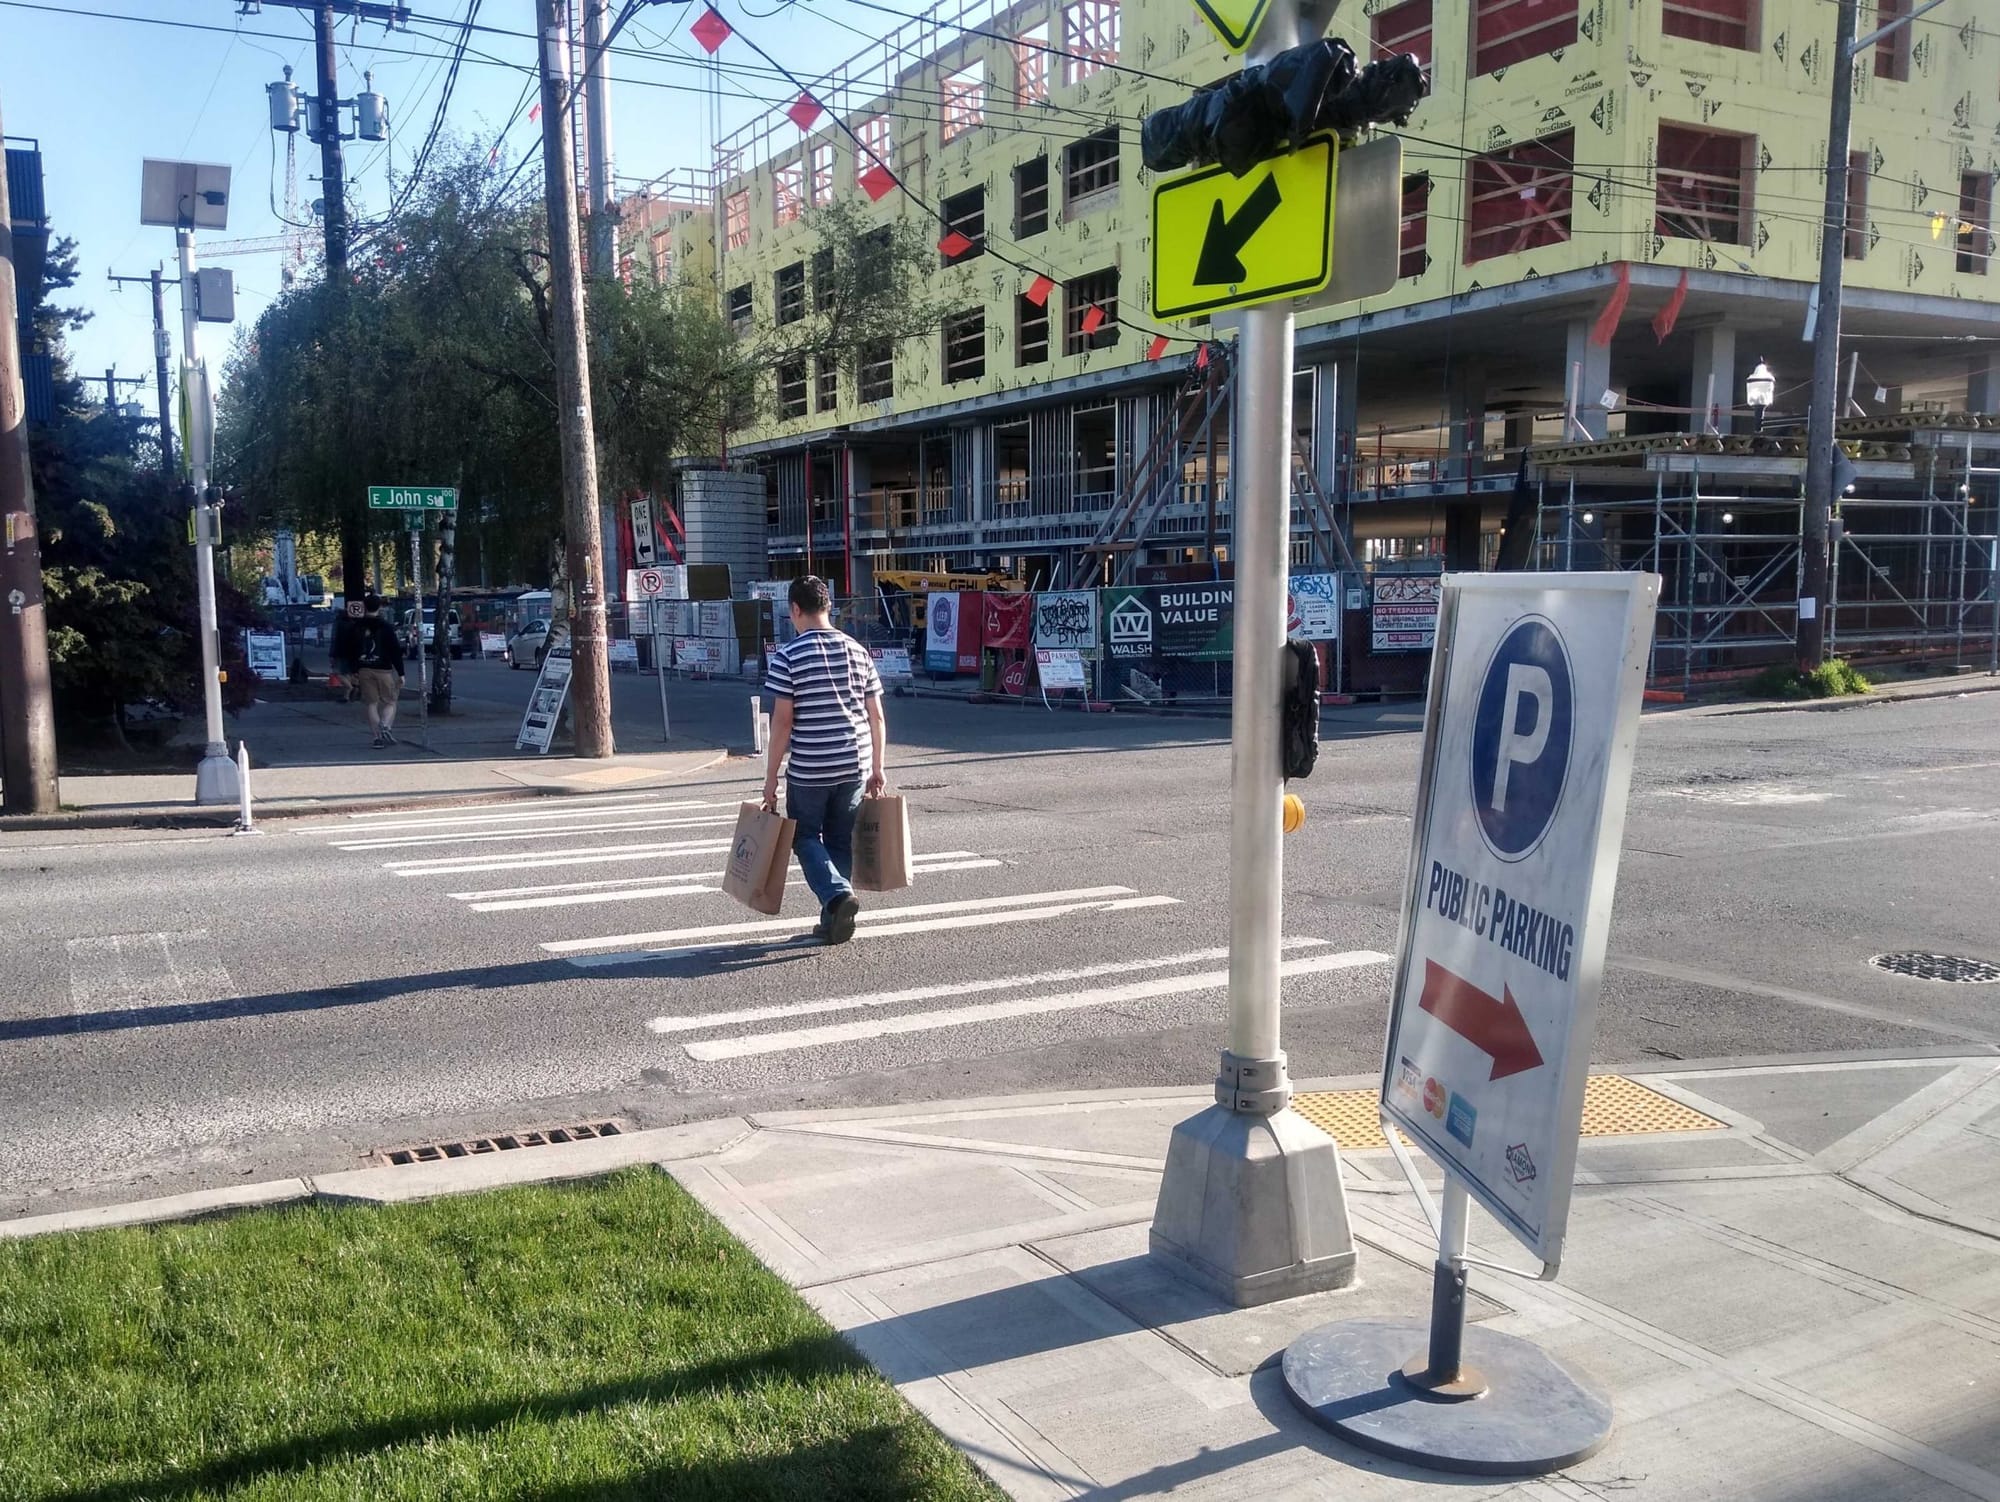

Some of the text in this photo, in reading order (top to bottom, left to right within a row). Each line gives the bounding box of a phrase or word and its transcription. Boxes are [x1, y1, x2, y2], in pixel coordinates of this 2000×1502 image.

[1564, 79, 1604, 97] DensGlass
[1546, 107, 1561, 120] GP
[1535, 119, 1572, 137] DensGlass
[372, 494, 380, 504] E
[386, 489, 421, 505] John
[634, 504, 647, 521] ONE
[636, 520, 648, 538] WAY
[1160, 590, 1233, 608] BUILDIN
[1160, 608, 1218, 624] VALUE
[1038, 652, 1079, 662] NO PARKING
[1110, 644, 1152, 654] WALSH
[1491, 662, 1553, 813] P
[1427, 860, 1574, 982] PUBLIC PARKING
